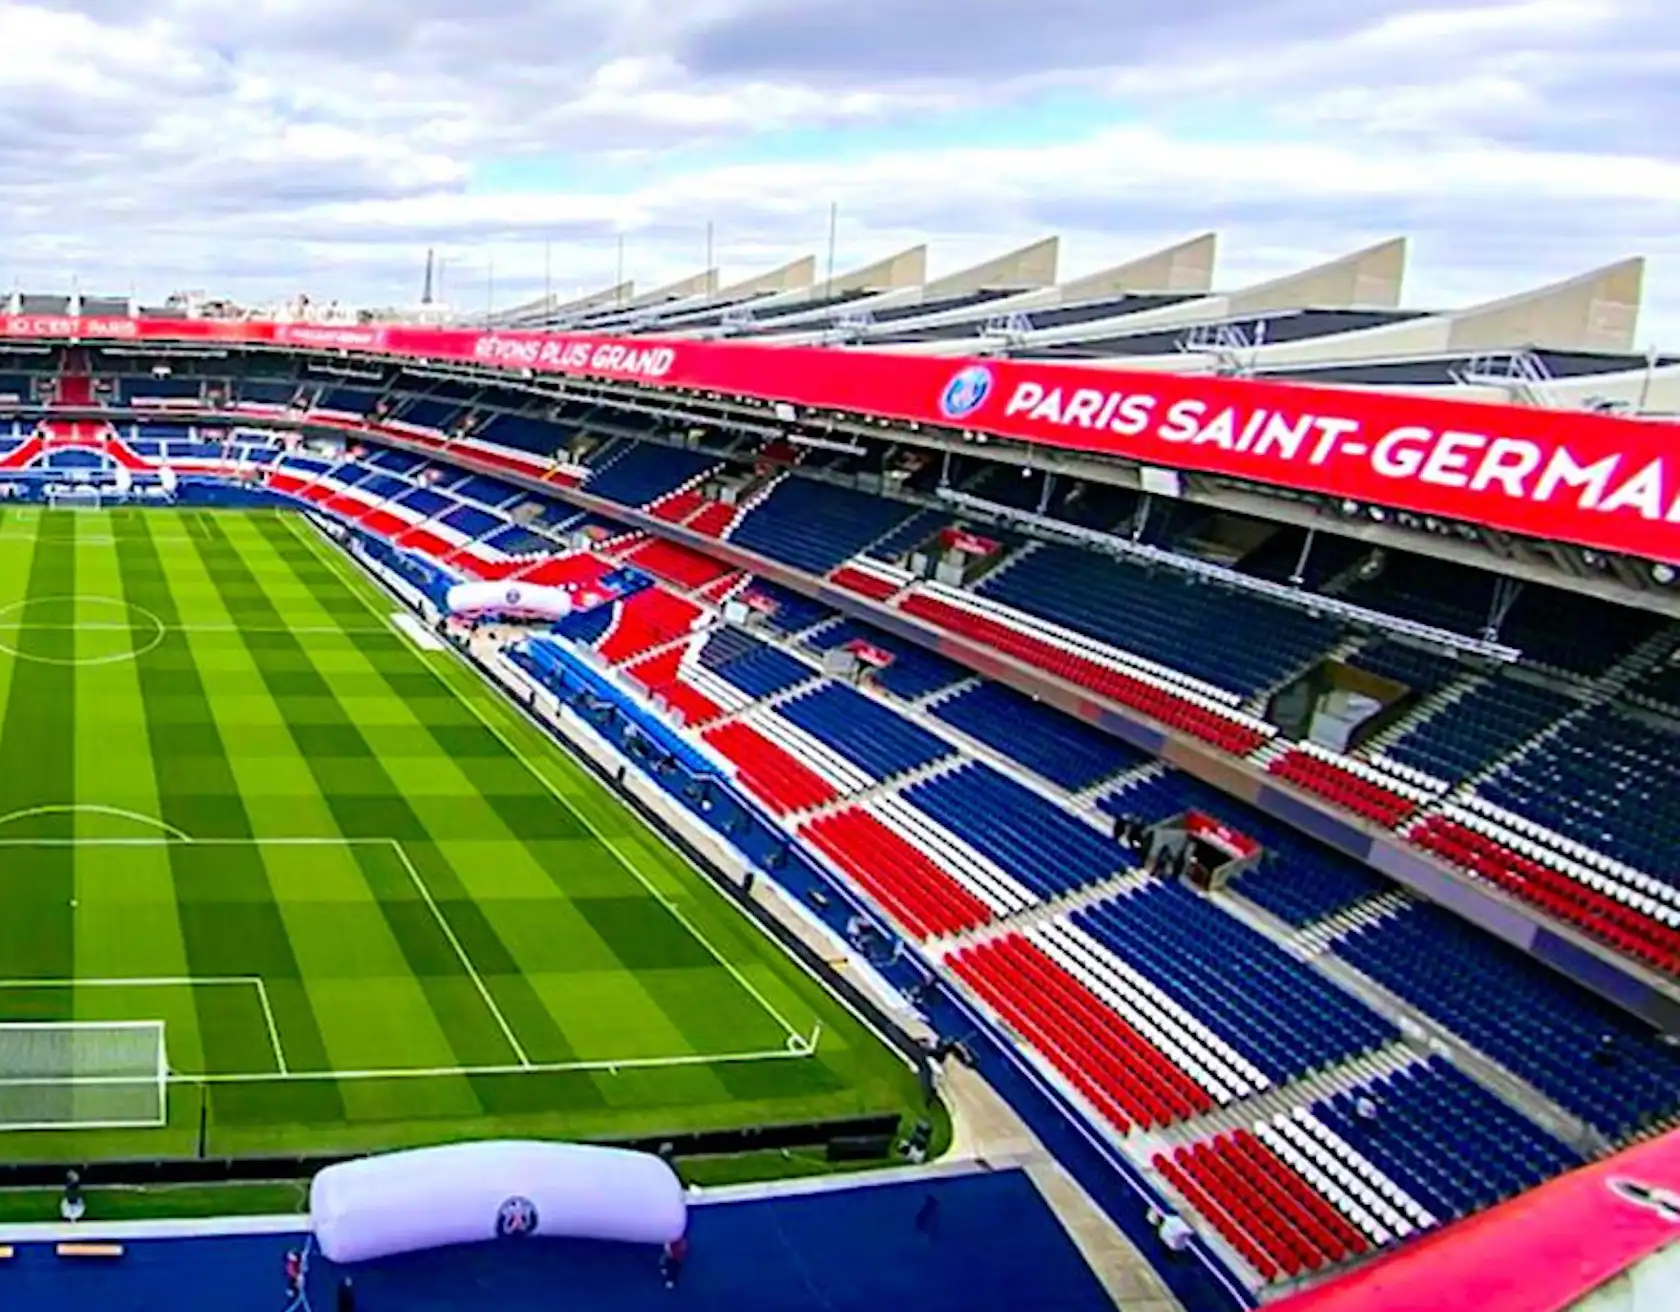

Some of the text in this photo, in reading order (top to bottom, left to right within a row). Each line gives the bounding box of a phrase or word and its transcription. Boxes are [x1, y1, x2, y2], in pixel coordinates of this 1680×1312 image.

[539, 340, 592, 368] PLUS
[591, 344, 674, 376] GRAND
[1006, 382, 1156, 435] PARIS
